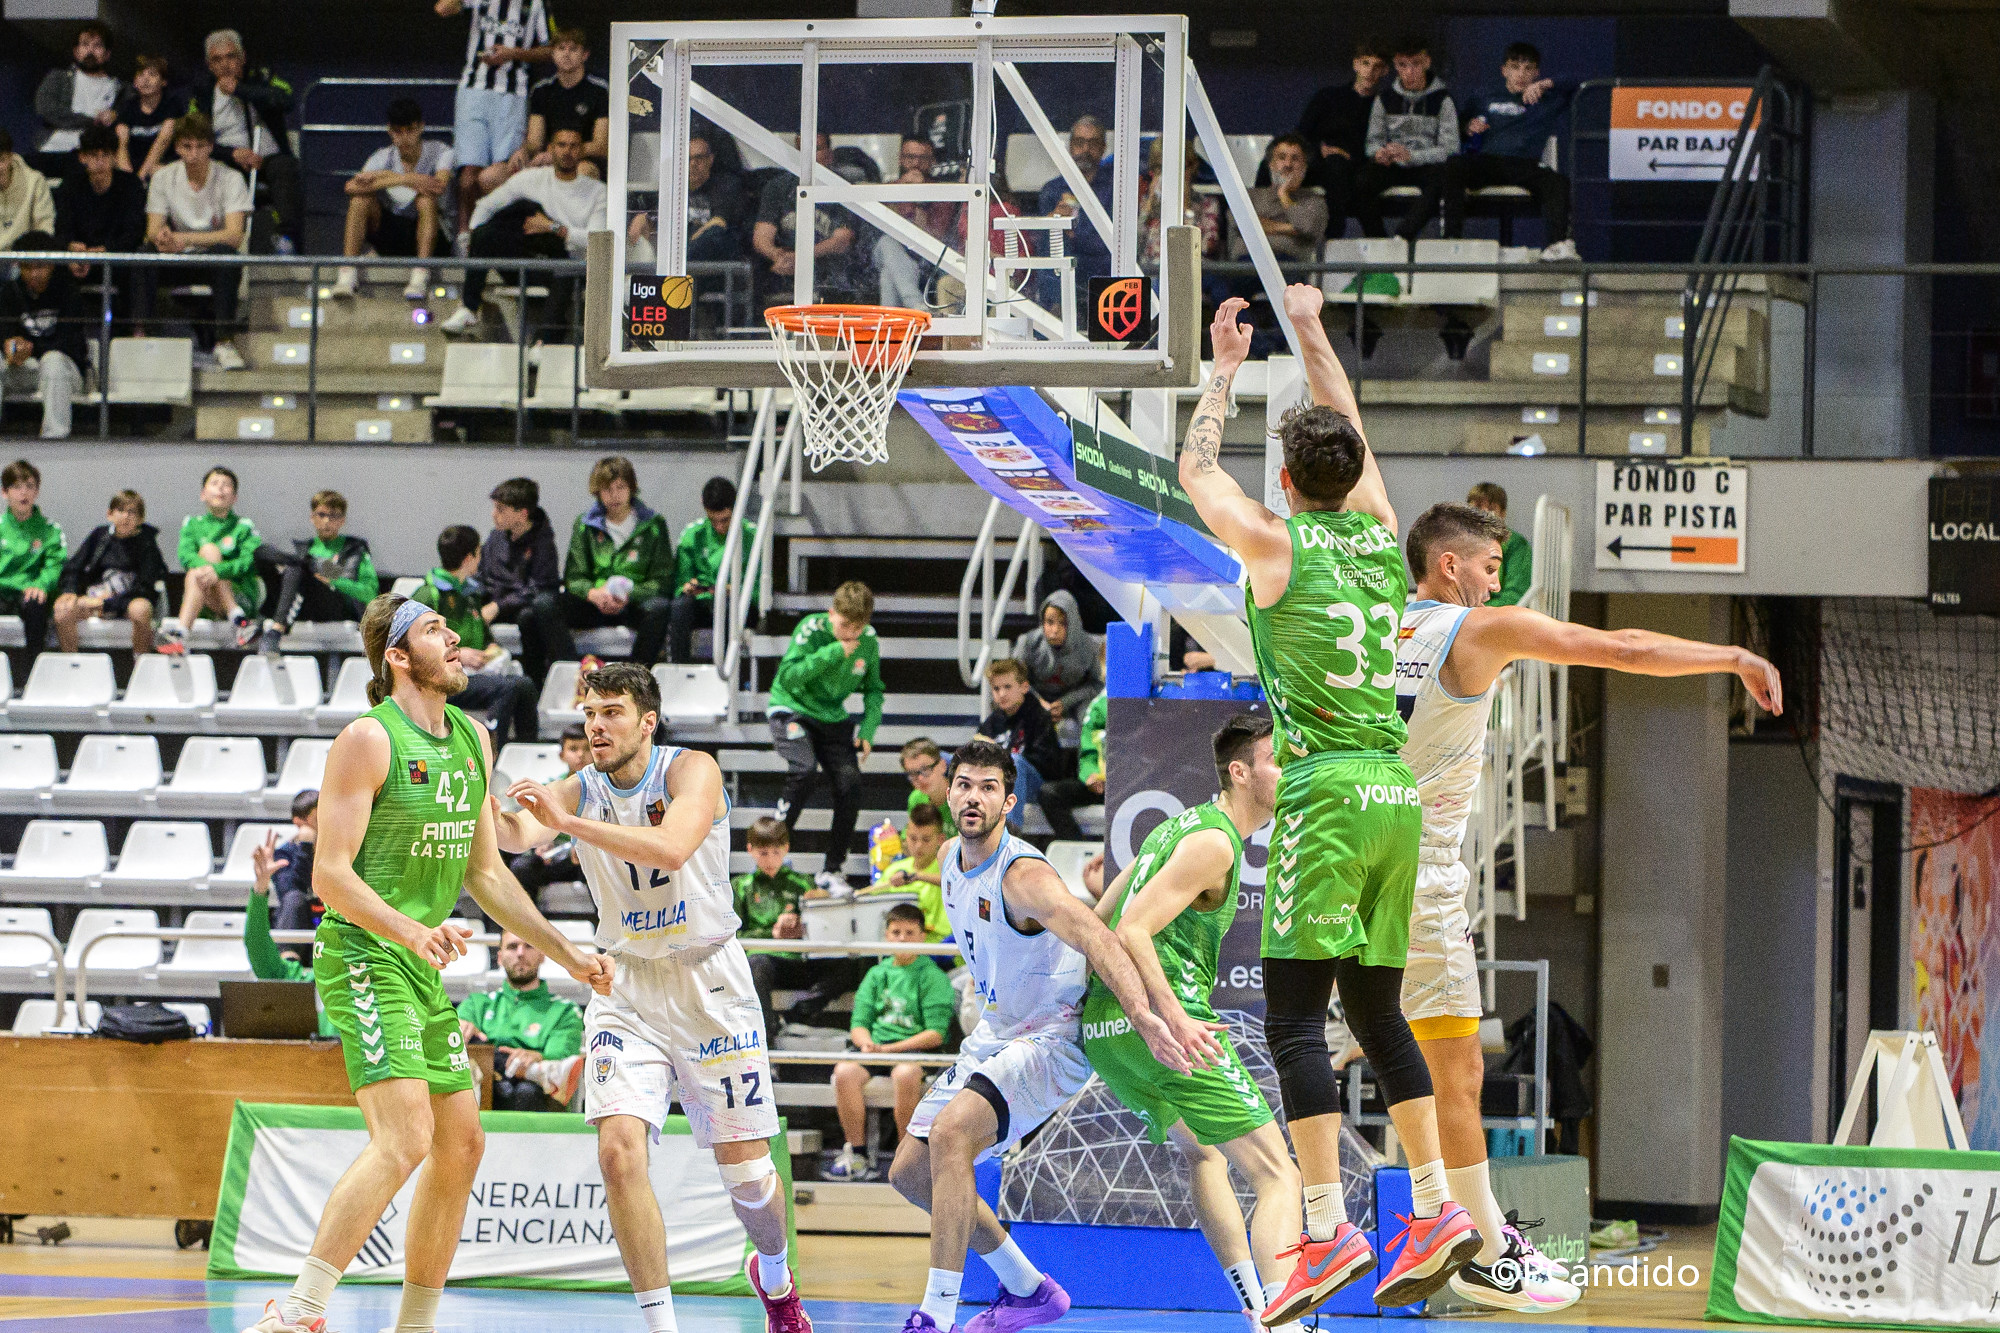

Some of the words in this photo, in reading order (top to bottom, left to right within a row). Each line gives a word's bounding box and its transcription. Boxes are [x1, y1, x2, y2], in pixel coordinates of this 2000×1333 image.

[1636, 101, 1722, 119] FONDO
[1728, 101, 1745, 119] C
[1638, 136, 1679, 151] PAR
[632, 282, 656, 298] Liga
[1124, 282, 1139, 290] FEB
[631, 305, 668, 321] LEB
[631, 323, 665, 336] ORO
[1613, 467, 1696, 493] FONDO
[1715, 470, 1730, 494] C
[1605, 502, 1652, 527] PAR
[1663, 503, 1737, 530] PISTA
[1930, 521, 2000, 541] LOCAL
[1325, 601, 1399, 690] 33
[1396, 661, 1430, 679] RADO
[436, 770, 471, 813] 42
[422, 820, 476, 841] AMICS
[700, 1029, 761, 1060] MELILLA
[720, 1071, 763, 1109] 12
[471, 1182, 608, 1209] NERALIT
[459, 1217, 616, 1245] ENCIAN
